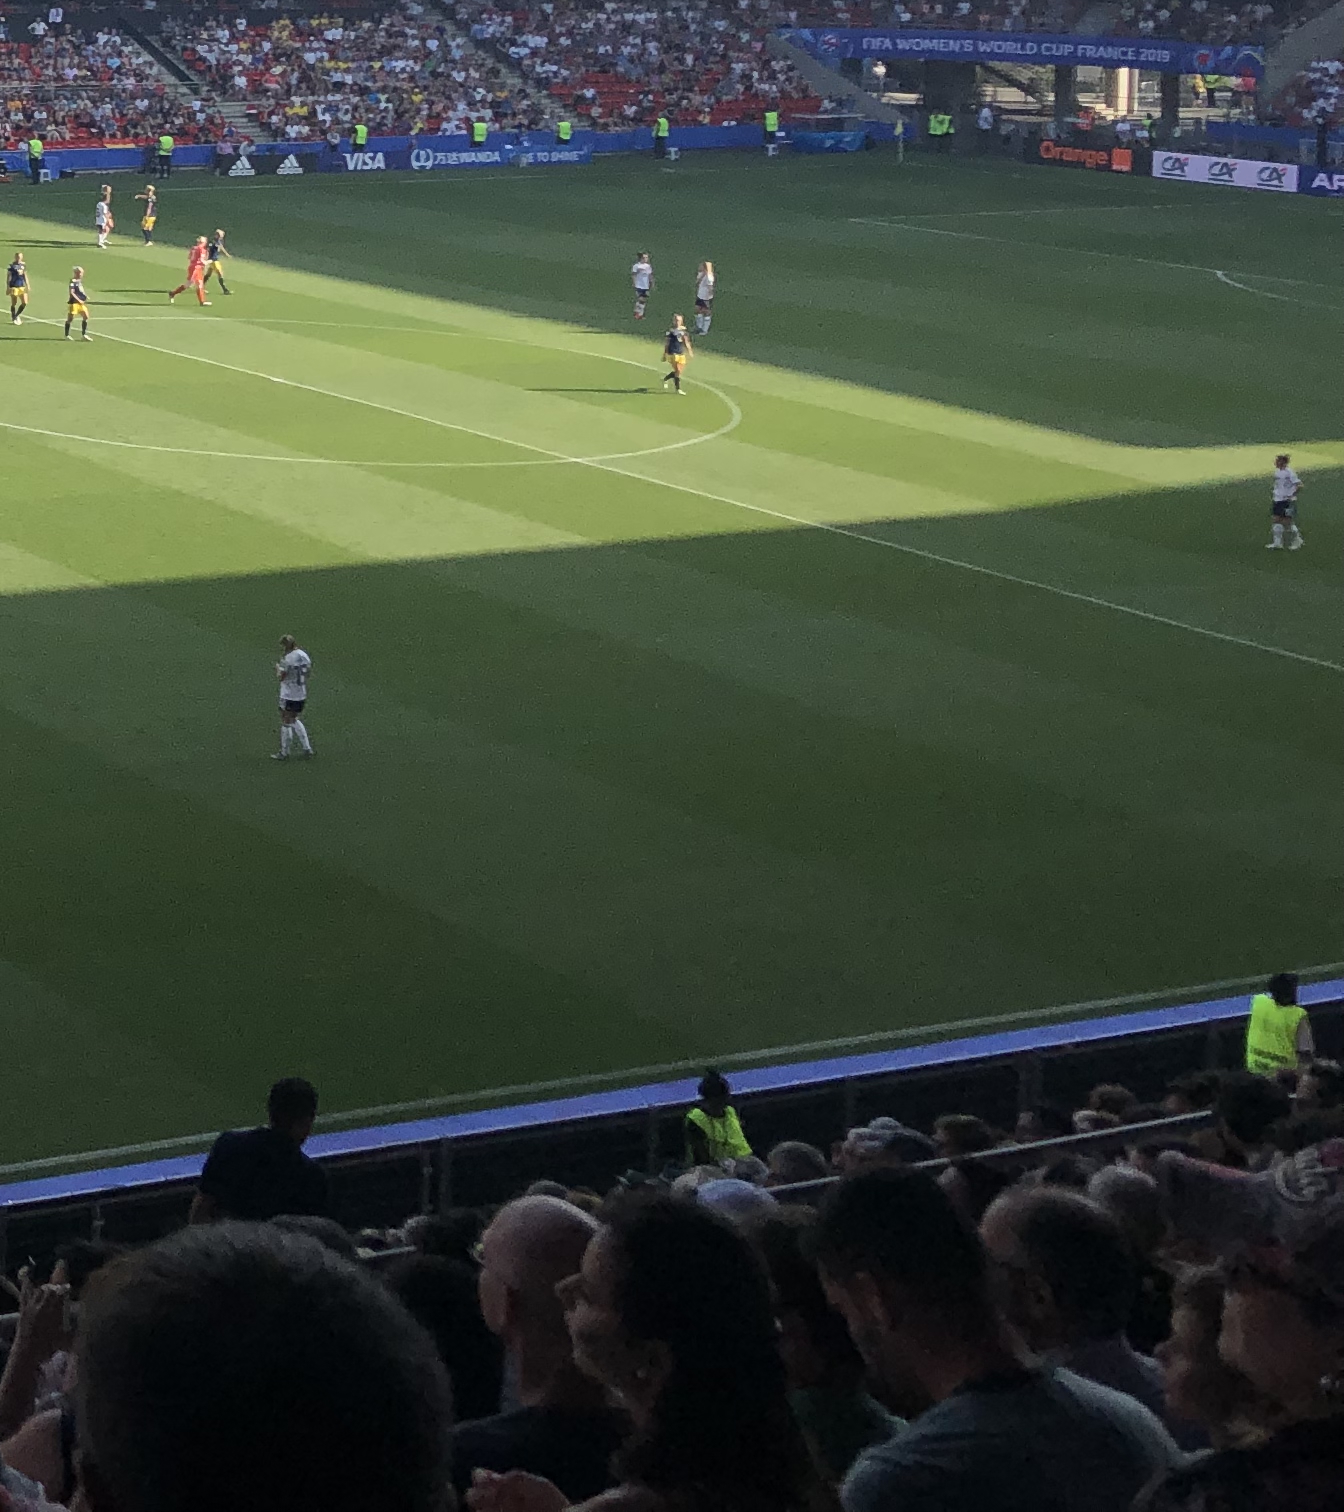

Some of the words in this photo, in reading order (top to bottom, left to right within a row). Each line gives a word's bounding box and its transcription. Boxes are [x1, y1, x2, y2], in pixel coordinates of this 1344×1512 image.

[862, 37, 892, 50] FIFA
[896, 38, 973, 52] WOMEN'S
[976, 41, 1037, 54] WORLD
[1040, 42, 1074, 56] CUP
[1077, 45, 1137, 60] FRANCE
[343, 152, 386, 170] VISA
[1040, 140, 1108, 168] Orange
